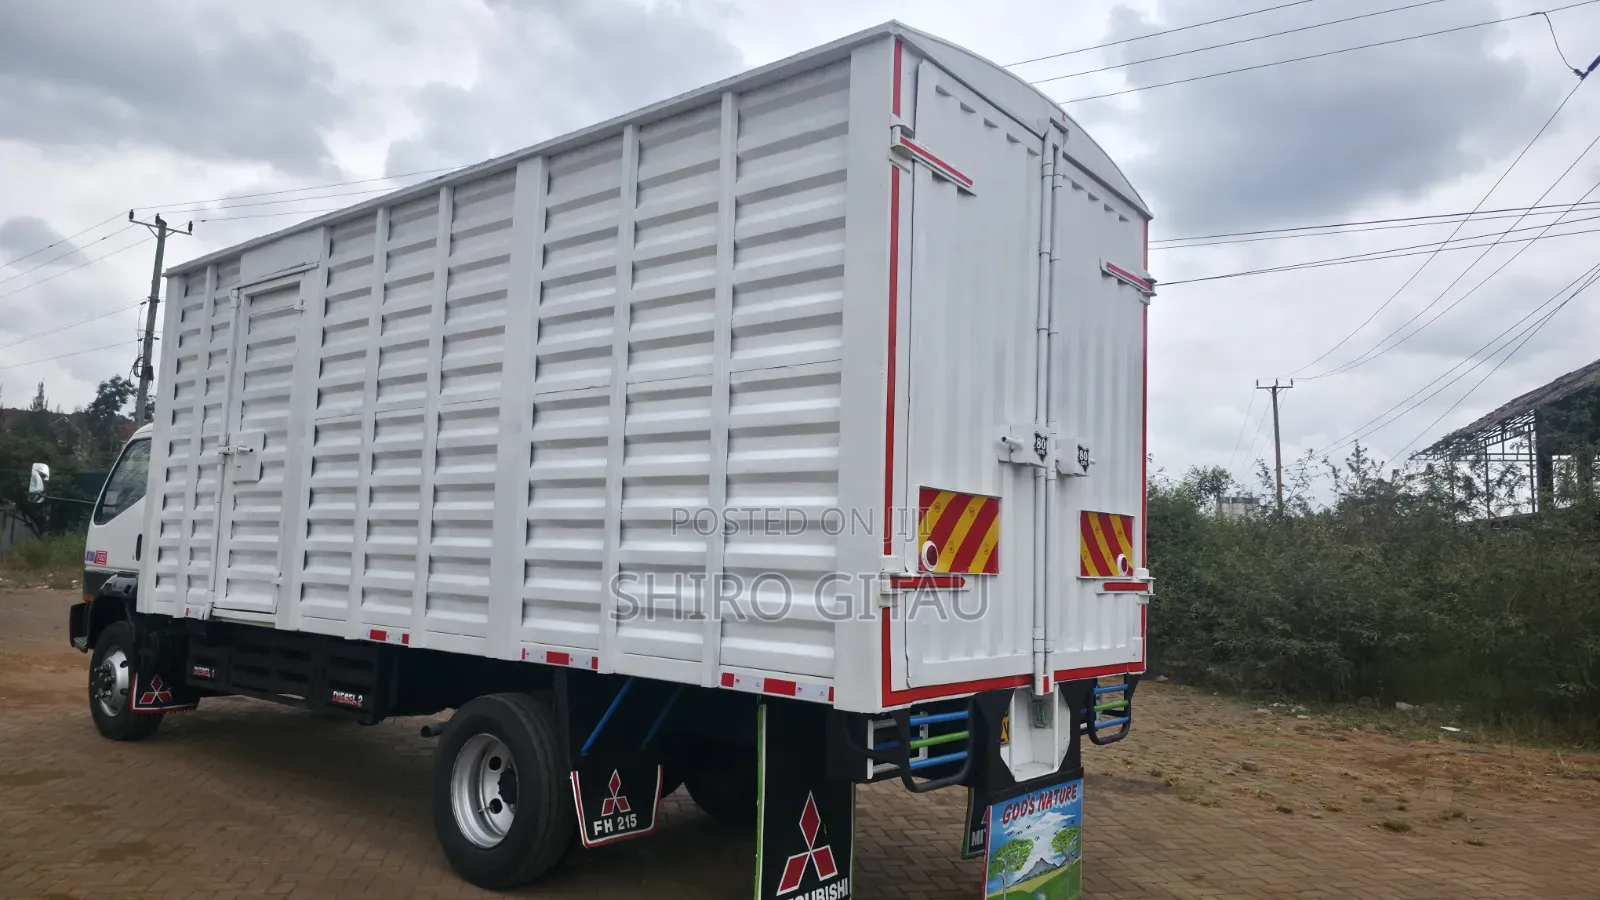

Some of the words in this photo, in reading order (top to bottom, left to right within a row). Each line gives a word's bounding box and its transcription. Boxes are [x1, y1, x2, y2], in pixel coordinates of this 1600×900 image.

[1036, 437, 1046, 450] 80
[1079, 449, 1088, 462] 80
[332, 690, 356, 705] DIESEL
[357, 694, 363, 708] 2
[1002, 793, 1035, 825] GOD'S
[1037, 783, 1079, 813] NATURE
[593, 818, 614, 836] FH
[617, 813, 638, 831] 215
[970, 828, 987, 847] MI
